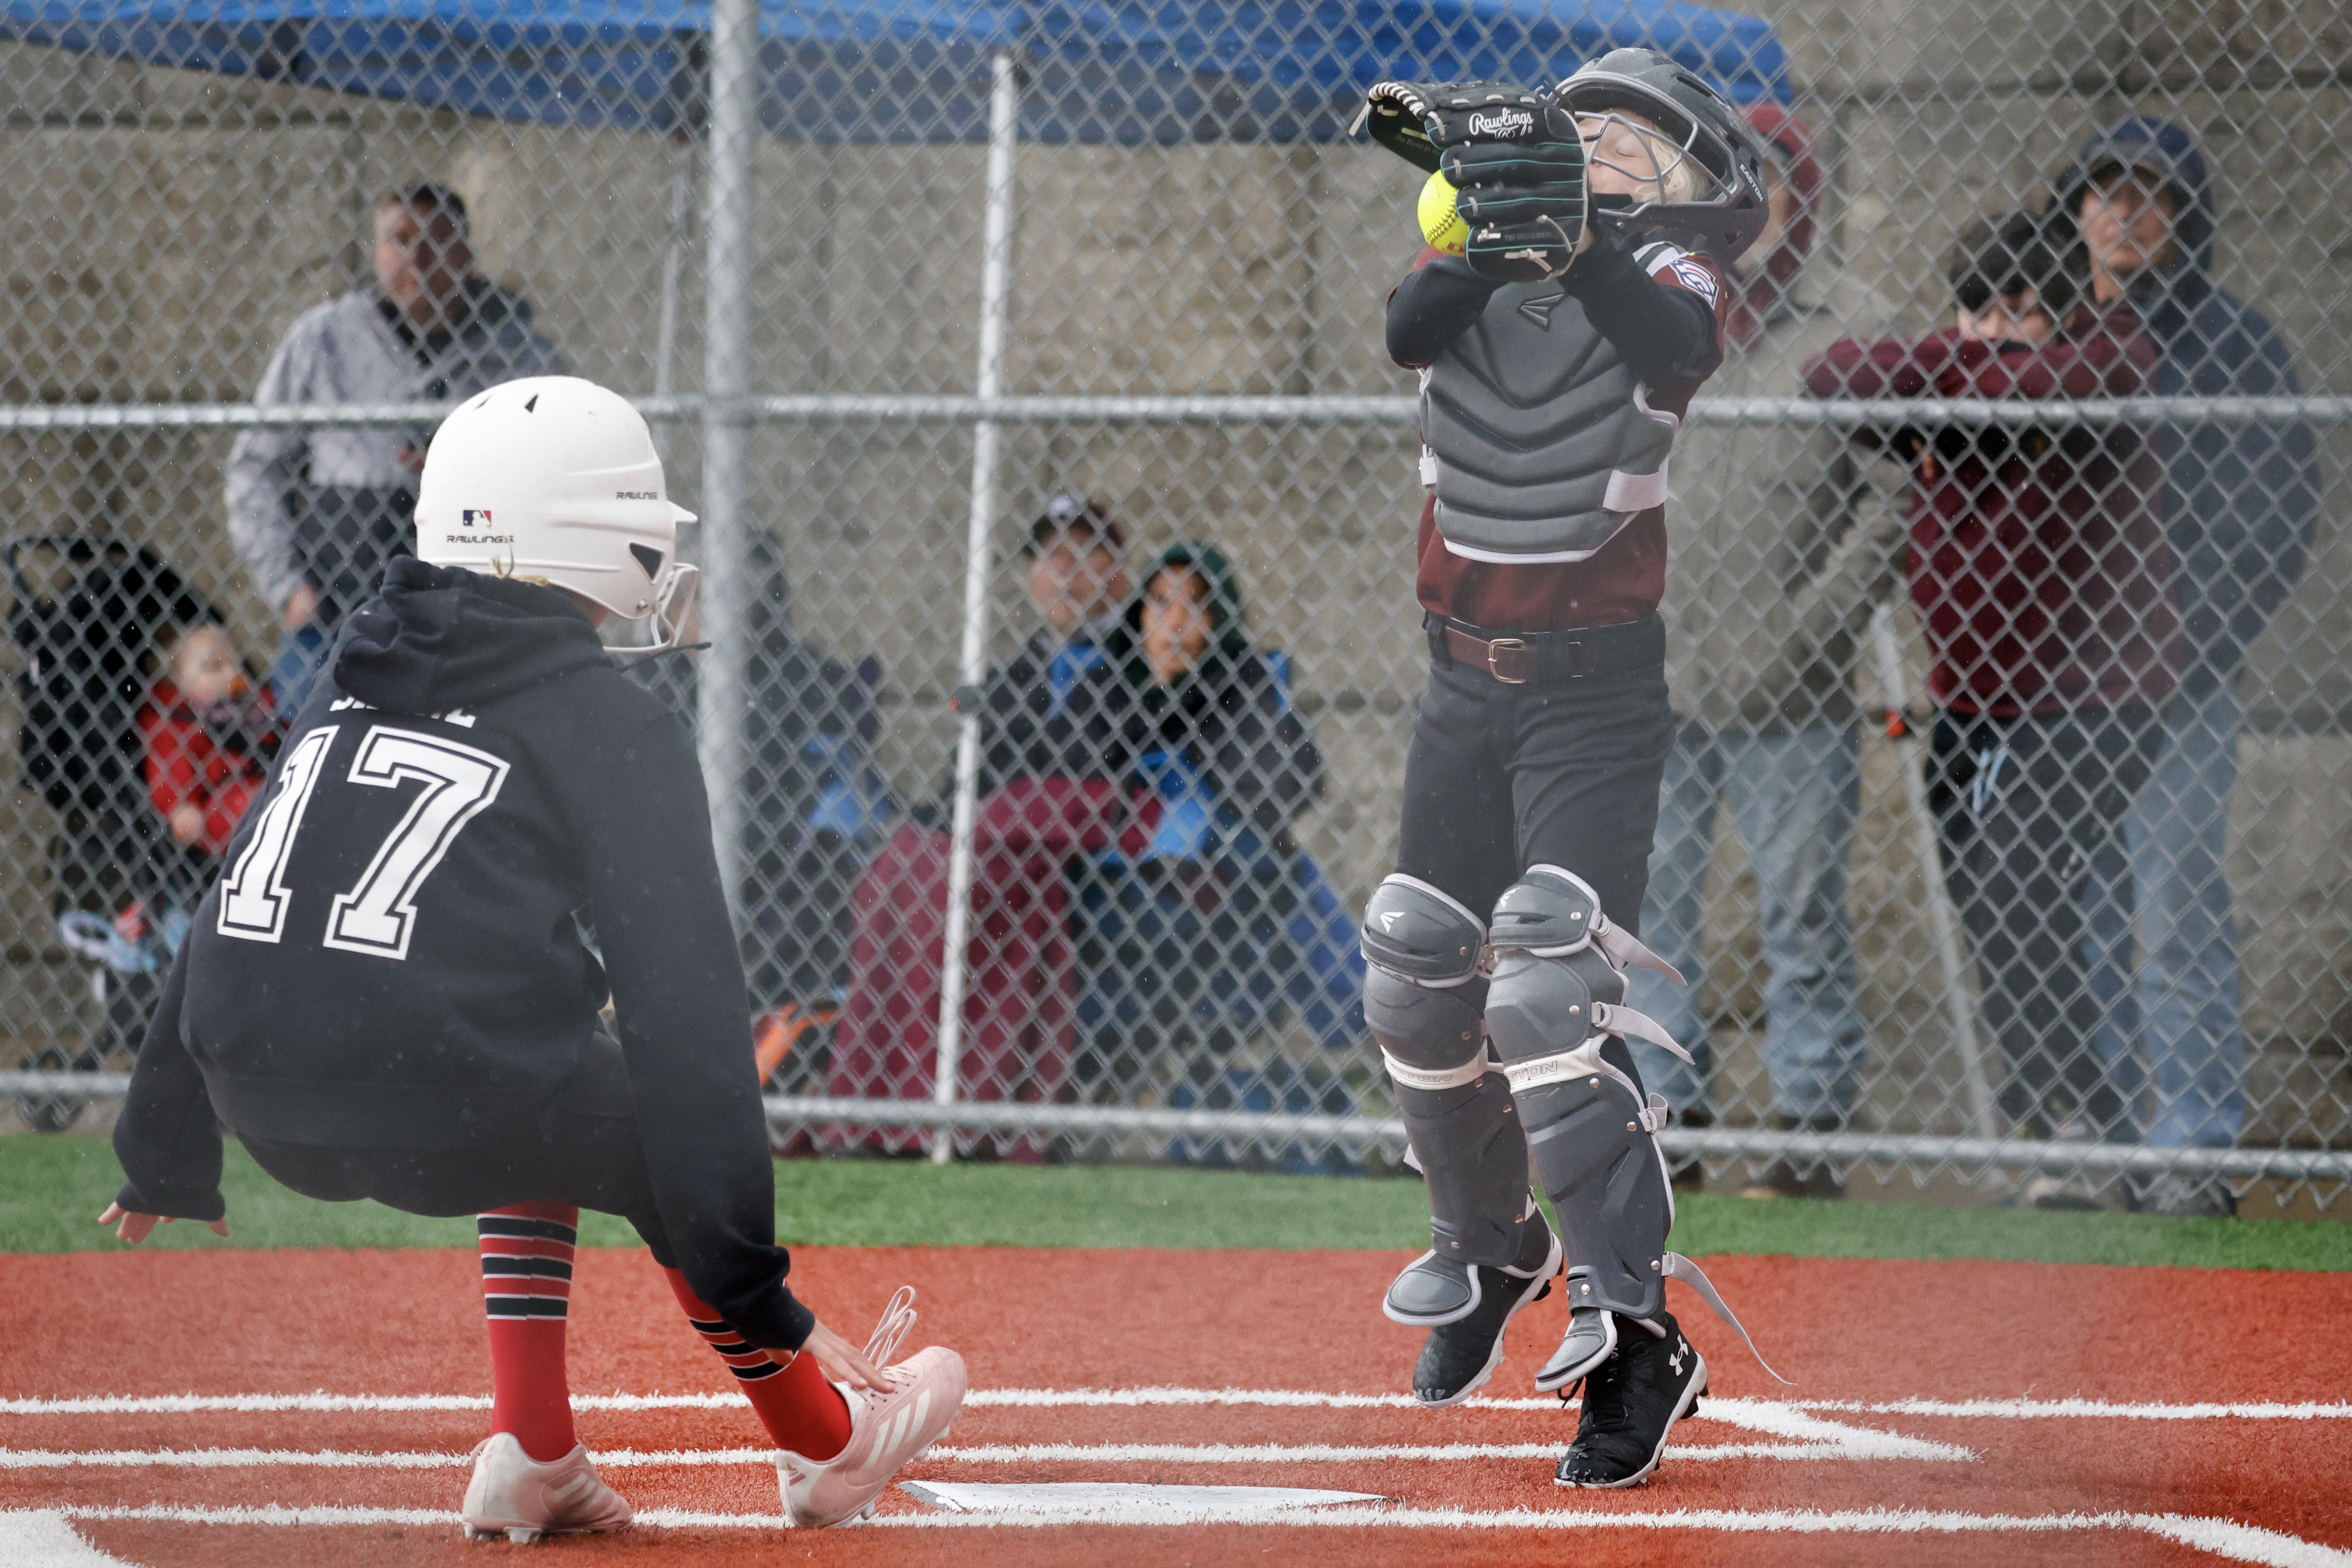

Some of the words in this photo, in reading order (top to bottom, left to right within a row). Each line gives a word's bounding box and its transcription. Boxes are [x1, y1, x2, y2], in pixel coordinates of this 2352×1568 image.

[1469, 107, 1534, 136] Rawlings
[1740, 164, 1764, 202] EASTON
[217, 724, 511, 961] 17
[1508, 1061, 1558, 1082] STON
